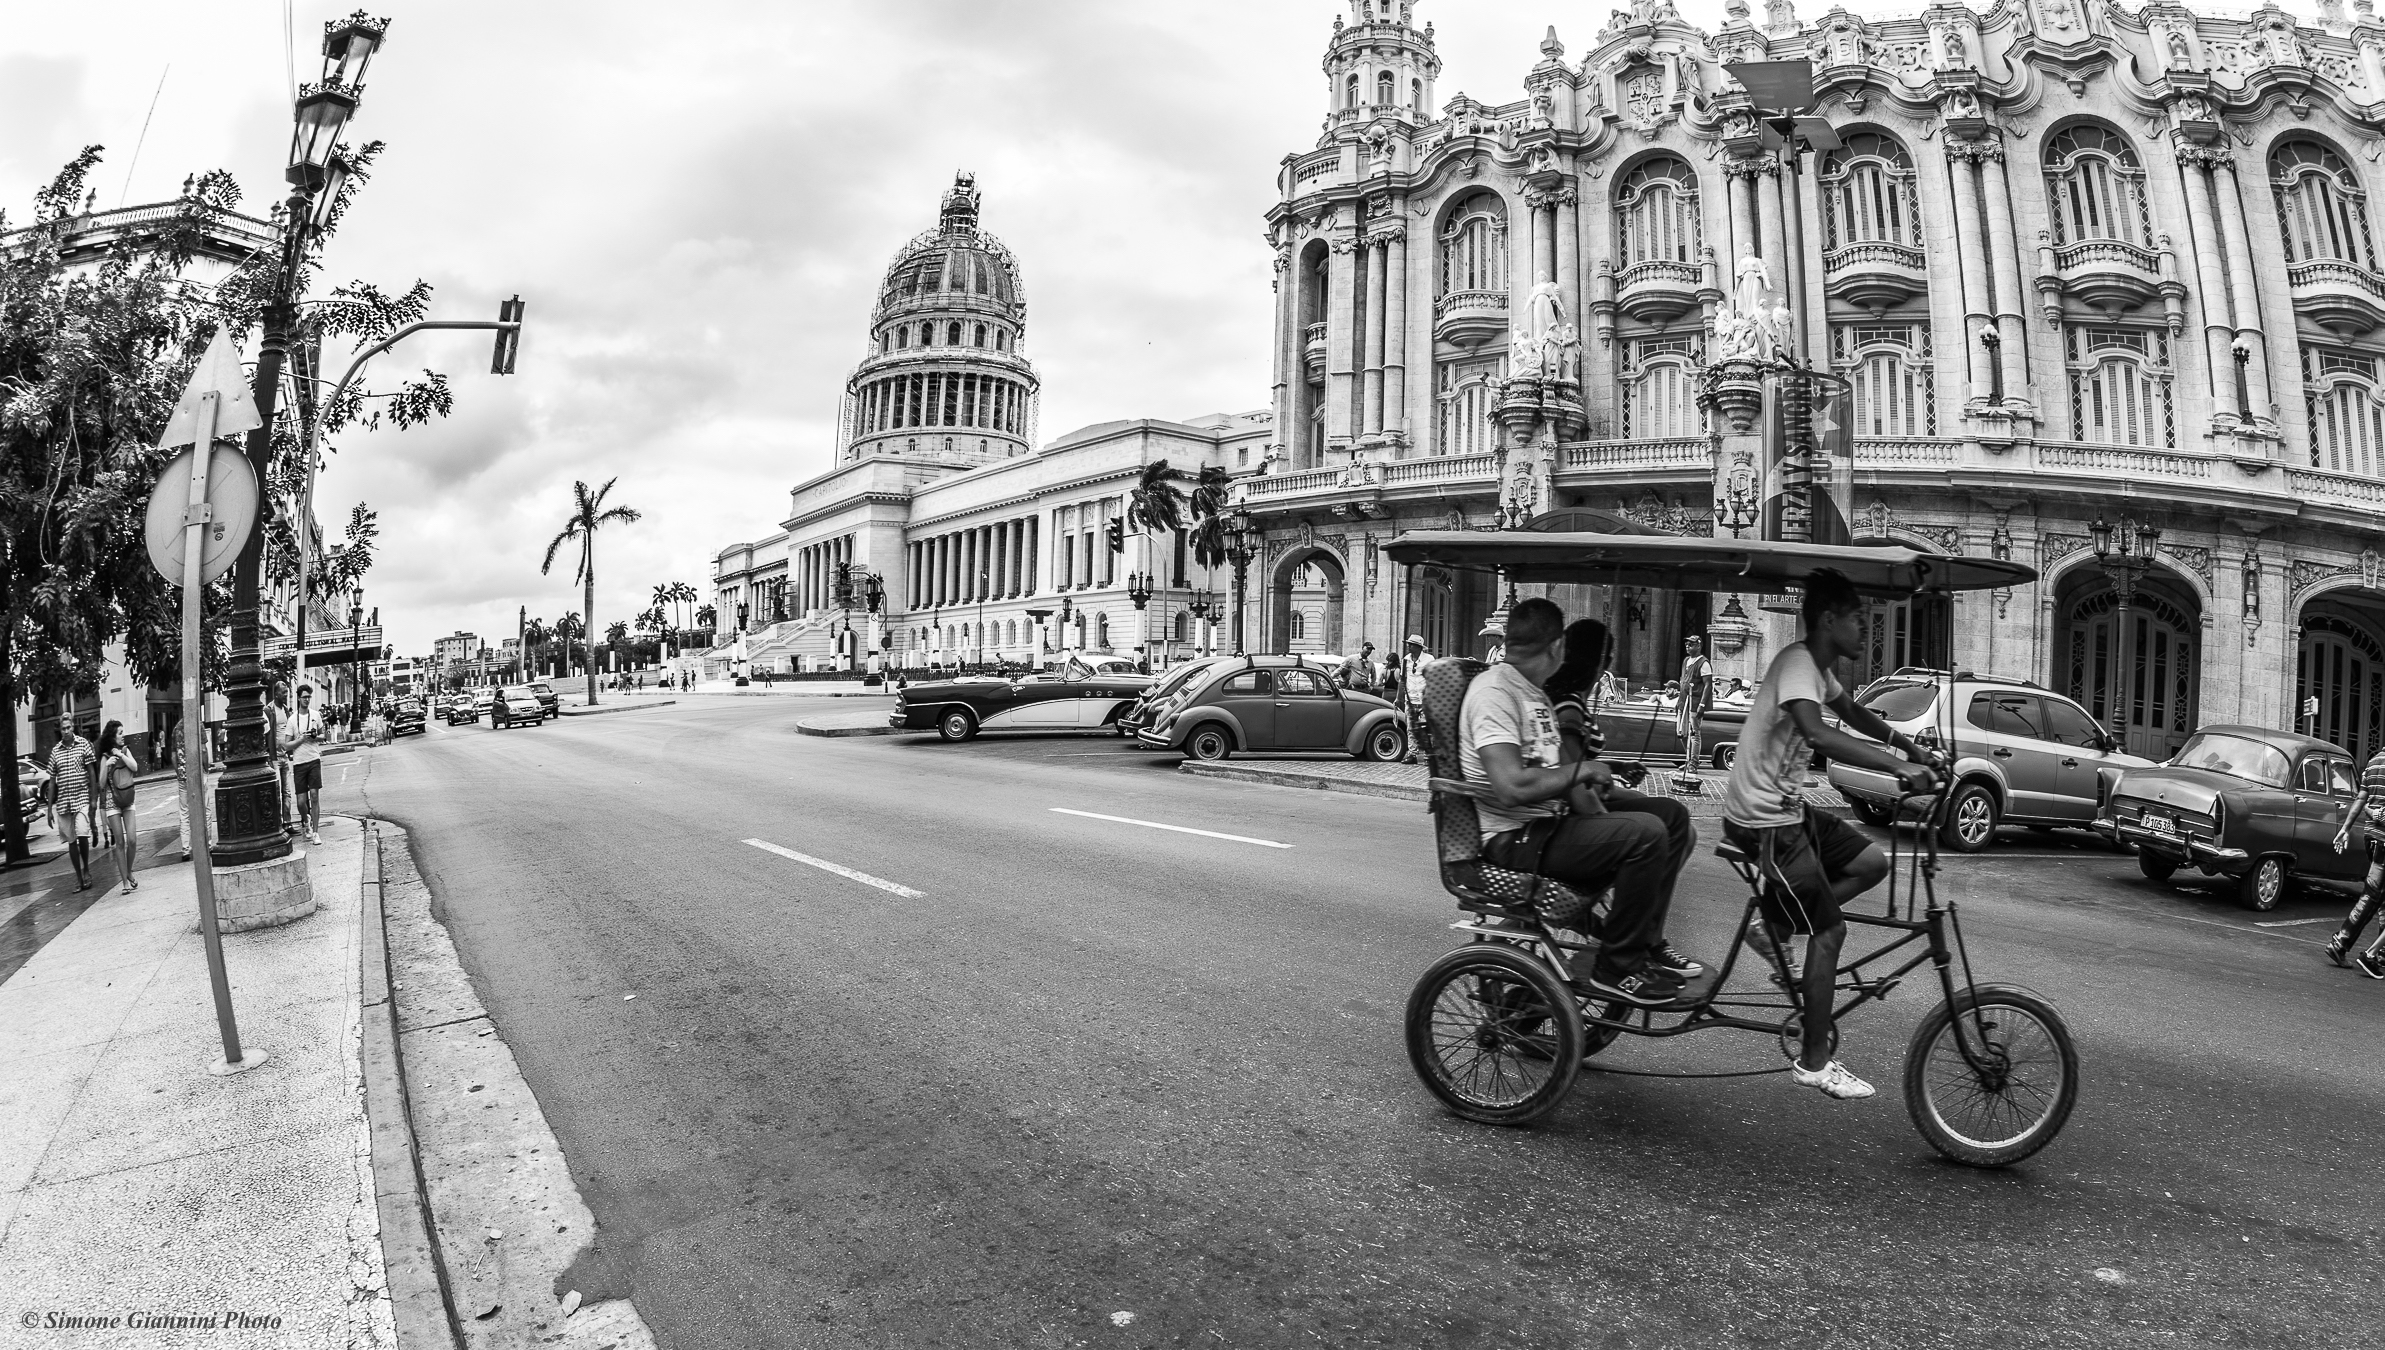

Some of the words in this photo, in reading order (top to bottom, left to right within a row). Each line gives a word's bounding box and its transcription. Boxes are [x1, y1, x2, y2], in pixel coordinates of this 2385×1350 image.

[1782, 376, 1813, 458] SANGRE
[1782, 461, 1813, 476] Y
[1781, 480, 1813, 544] UERZA
[1780, 595, 1798, 604] ARTE
[341, 635, 366, 643] PAYET
